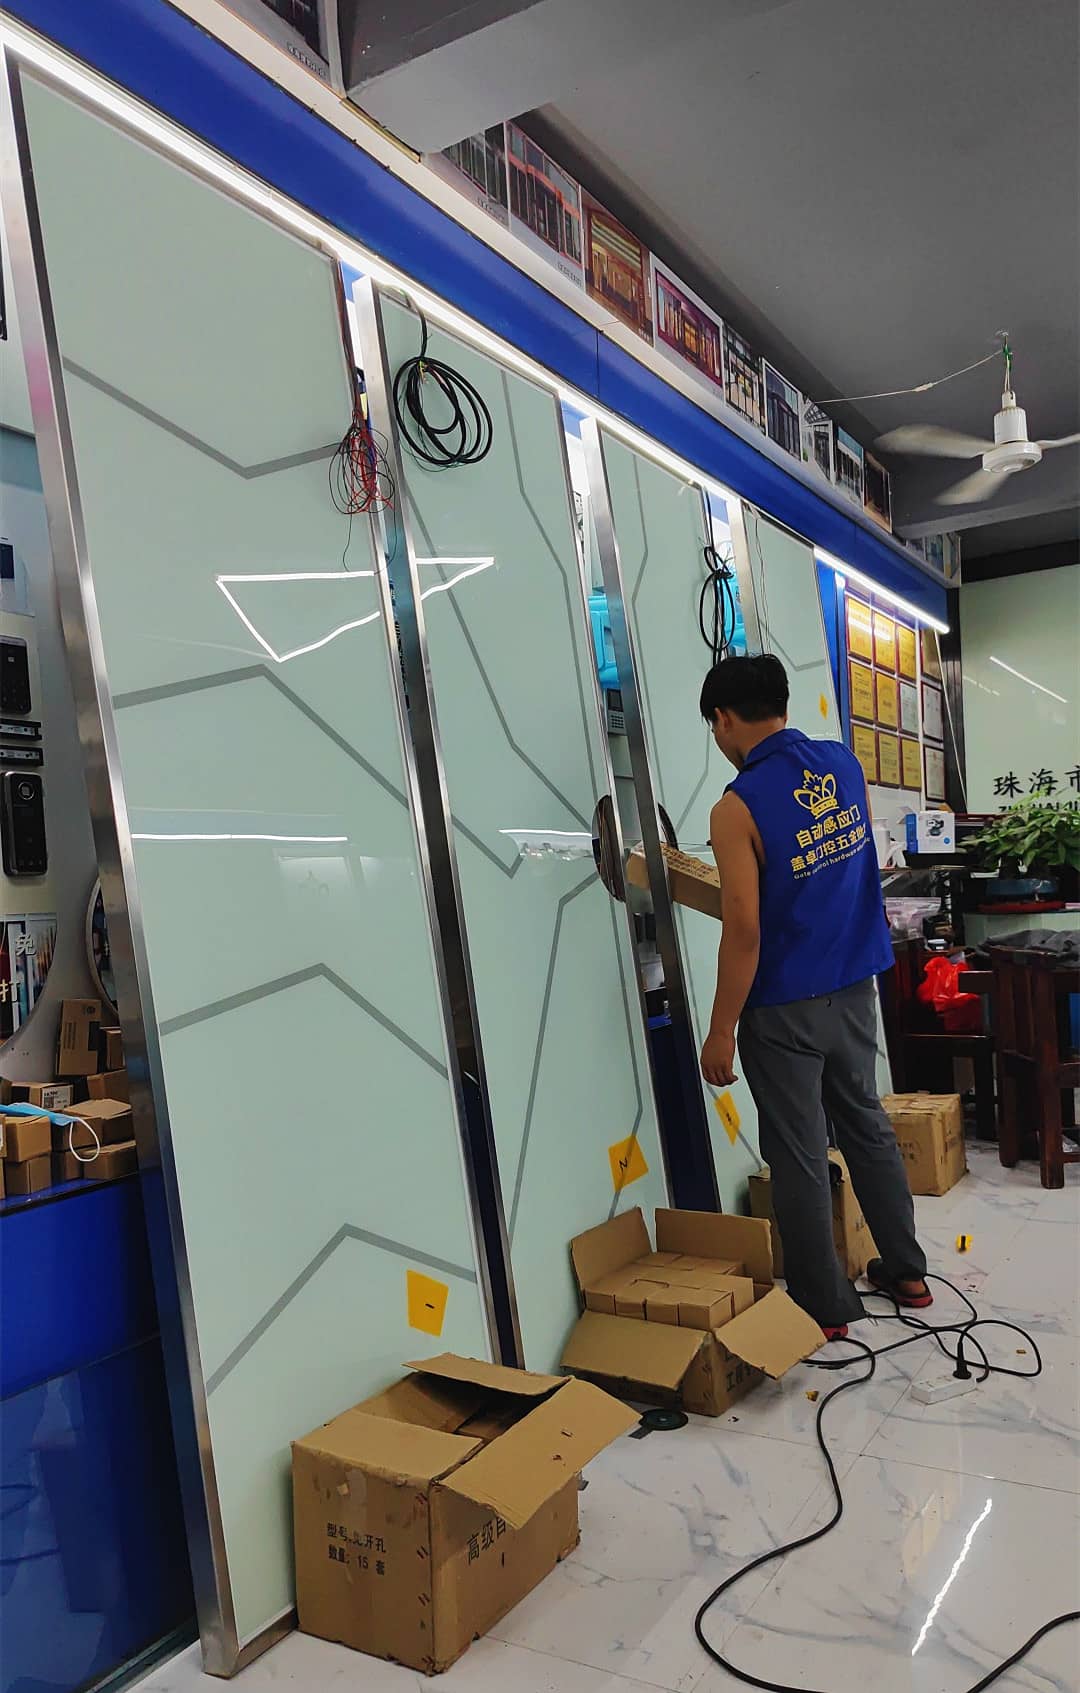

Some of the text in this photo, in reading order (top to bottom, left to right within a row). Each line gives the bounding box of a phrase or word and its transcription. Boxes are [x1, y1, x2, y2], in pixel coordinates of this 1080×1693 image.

[791, 823, 866, 872] 盖卓门控五金
[796, 804, 861, 849] 自动感应门
